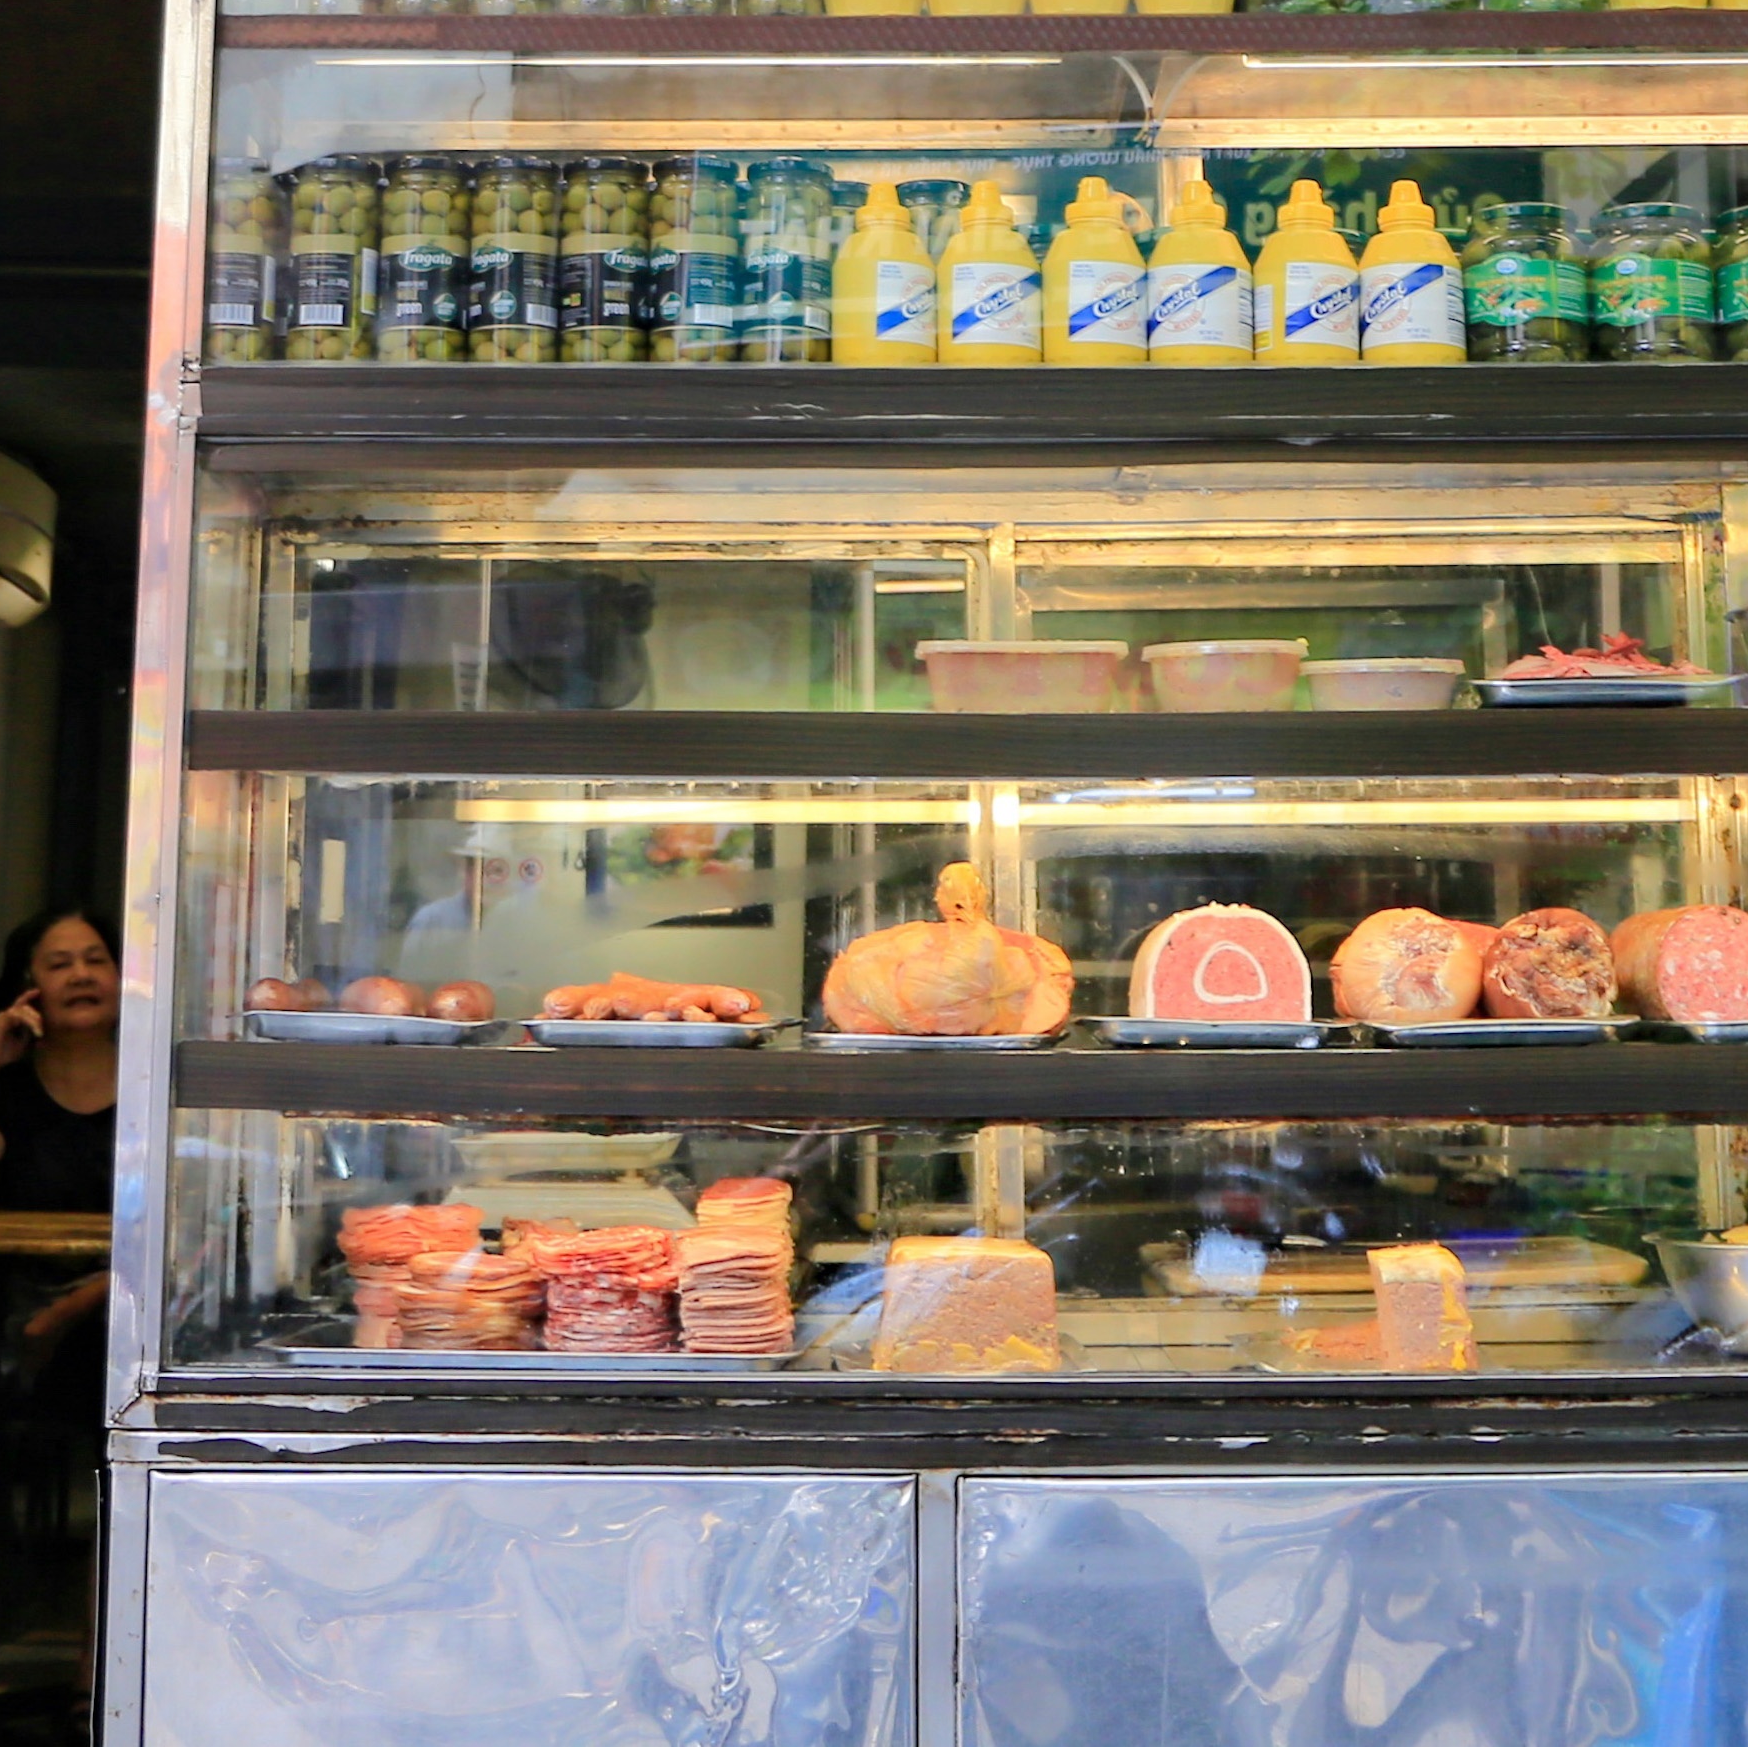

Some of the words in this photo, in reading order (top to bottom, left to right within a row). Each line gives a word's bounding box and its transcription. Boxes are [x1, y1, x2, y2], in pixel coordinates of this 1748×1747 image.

[403, 251, 452, 268] fragata
[973, 284, 1023, 320] Crystal
[1093, 286, 1138, 318] Crystal
[1155, 282, 1200, 322] Crystal
[1310, 286, 1352, 318] Crystal
[1365, 281, 1408, 323] Crystal
